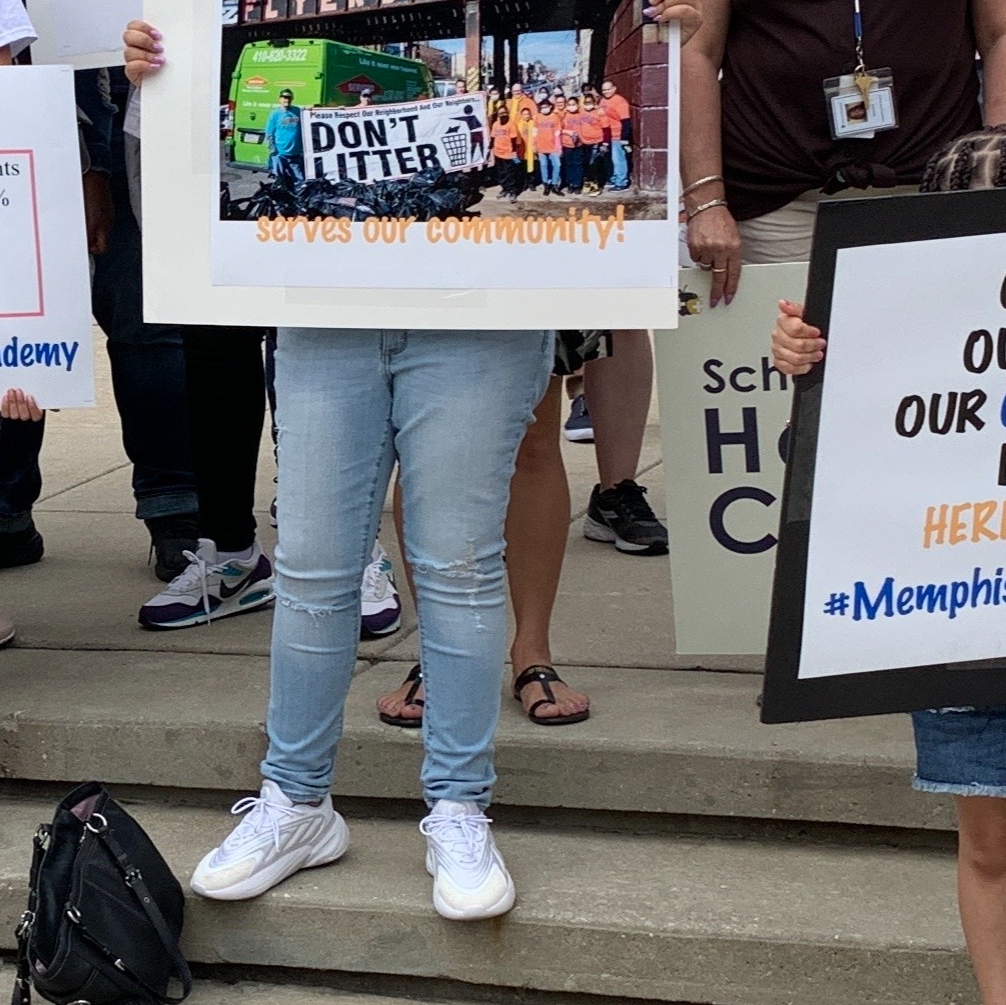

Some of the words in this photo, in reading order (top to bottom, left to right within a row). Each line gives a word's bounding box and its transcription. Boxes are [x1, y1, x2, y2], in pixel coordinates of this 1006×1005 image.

[311, 115, 419, 153] DON'T
[256, 213, 352, 245] serves
[362, 210, 415, 245] our
[426, 204, 626, 250] community!
[0, 336, 79, 372] demy
[895, 390, 988, 438] OUR
